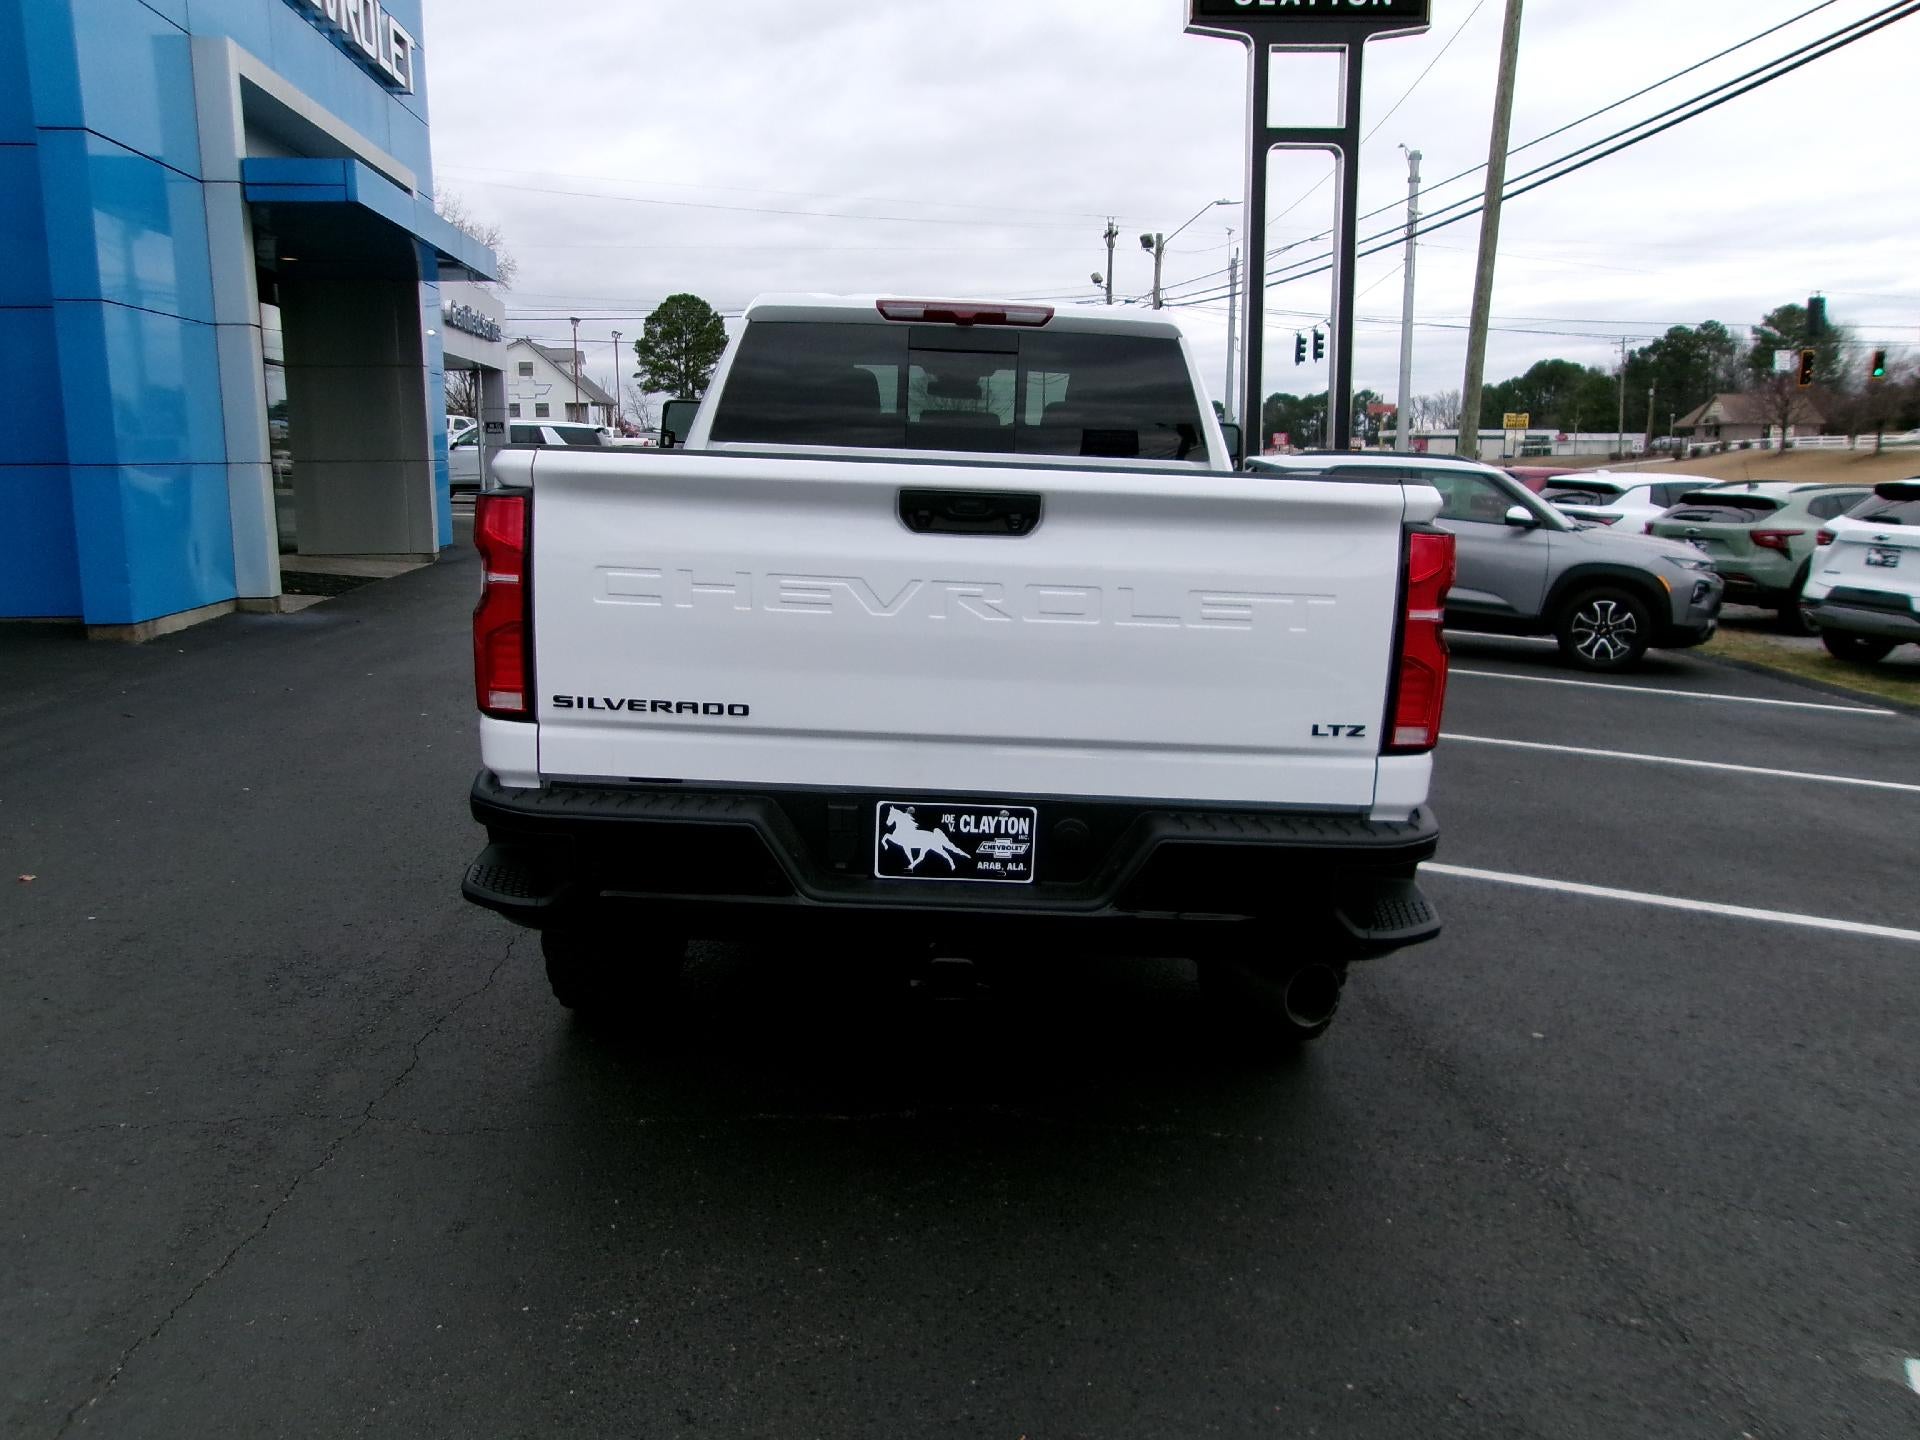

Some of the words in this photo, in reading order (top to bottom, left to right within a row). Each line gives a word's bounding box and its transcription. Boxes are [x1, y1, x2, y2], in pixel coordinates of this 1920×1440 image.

[308, 0, 417, 95] ROLET
[593, 564, 1337, 633] CHEVROLET
[552, 694, 750, 717] SILVERADO
[1311, 724, 1366, 737] LTZ
[941, 814, 956, 823] JOE
[959, 814, 1029, 834] CLAYTON
[948, 823, 956, 833] V.
[1007, 862, 1027, 871] ALA.
